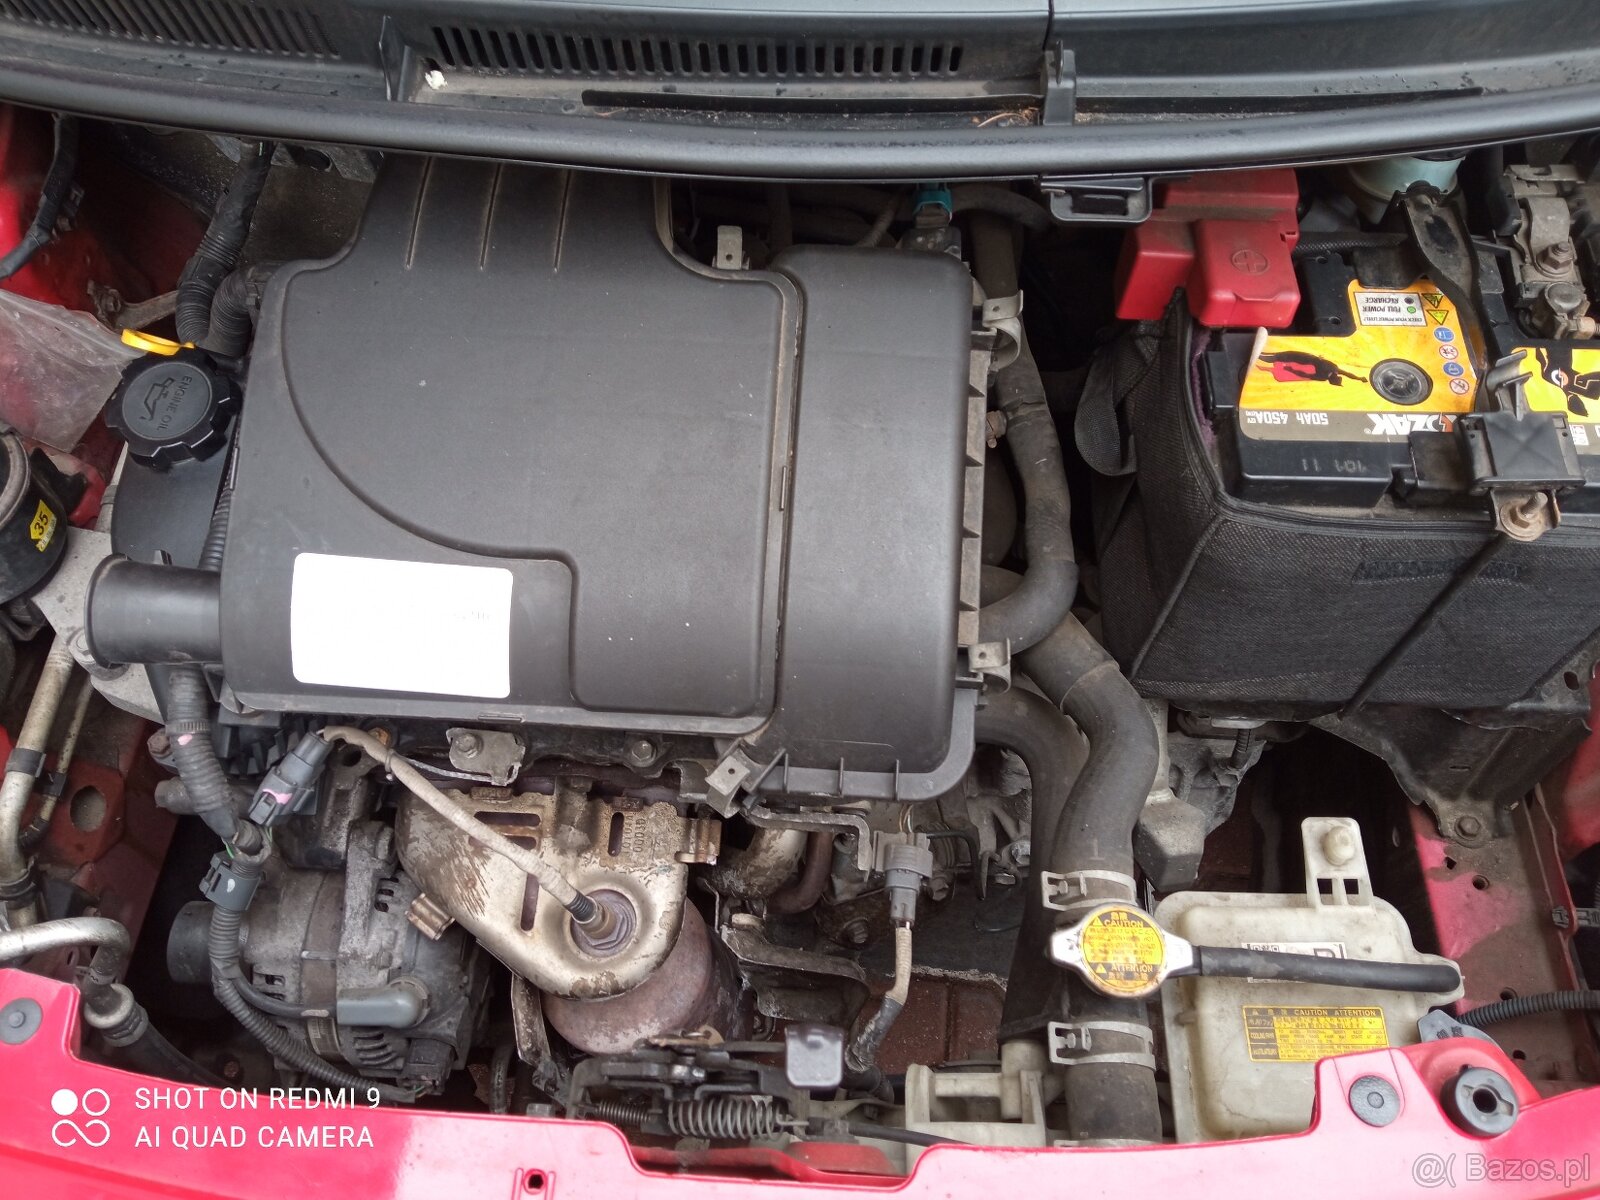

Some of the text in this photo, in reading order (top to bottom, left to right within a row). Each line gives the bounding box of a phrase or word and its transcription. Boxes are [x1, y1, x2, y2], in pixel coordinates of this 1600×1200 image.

[1362, 305, 1401, 313] FULL POWER
[157, 375, 193, 431] ENGINE OIL
[1256, 410, 1329, 426] 50Ah 450A
[34, 513, 49, 537] 35
[1104, 920, 1144, 928] CAUTION
[1111, 964, 1153, 972] ATTENTION
